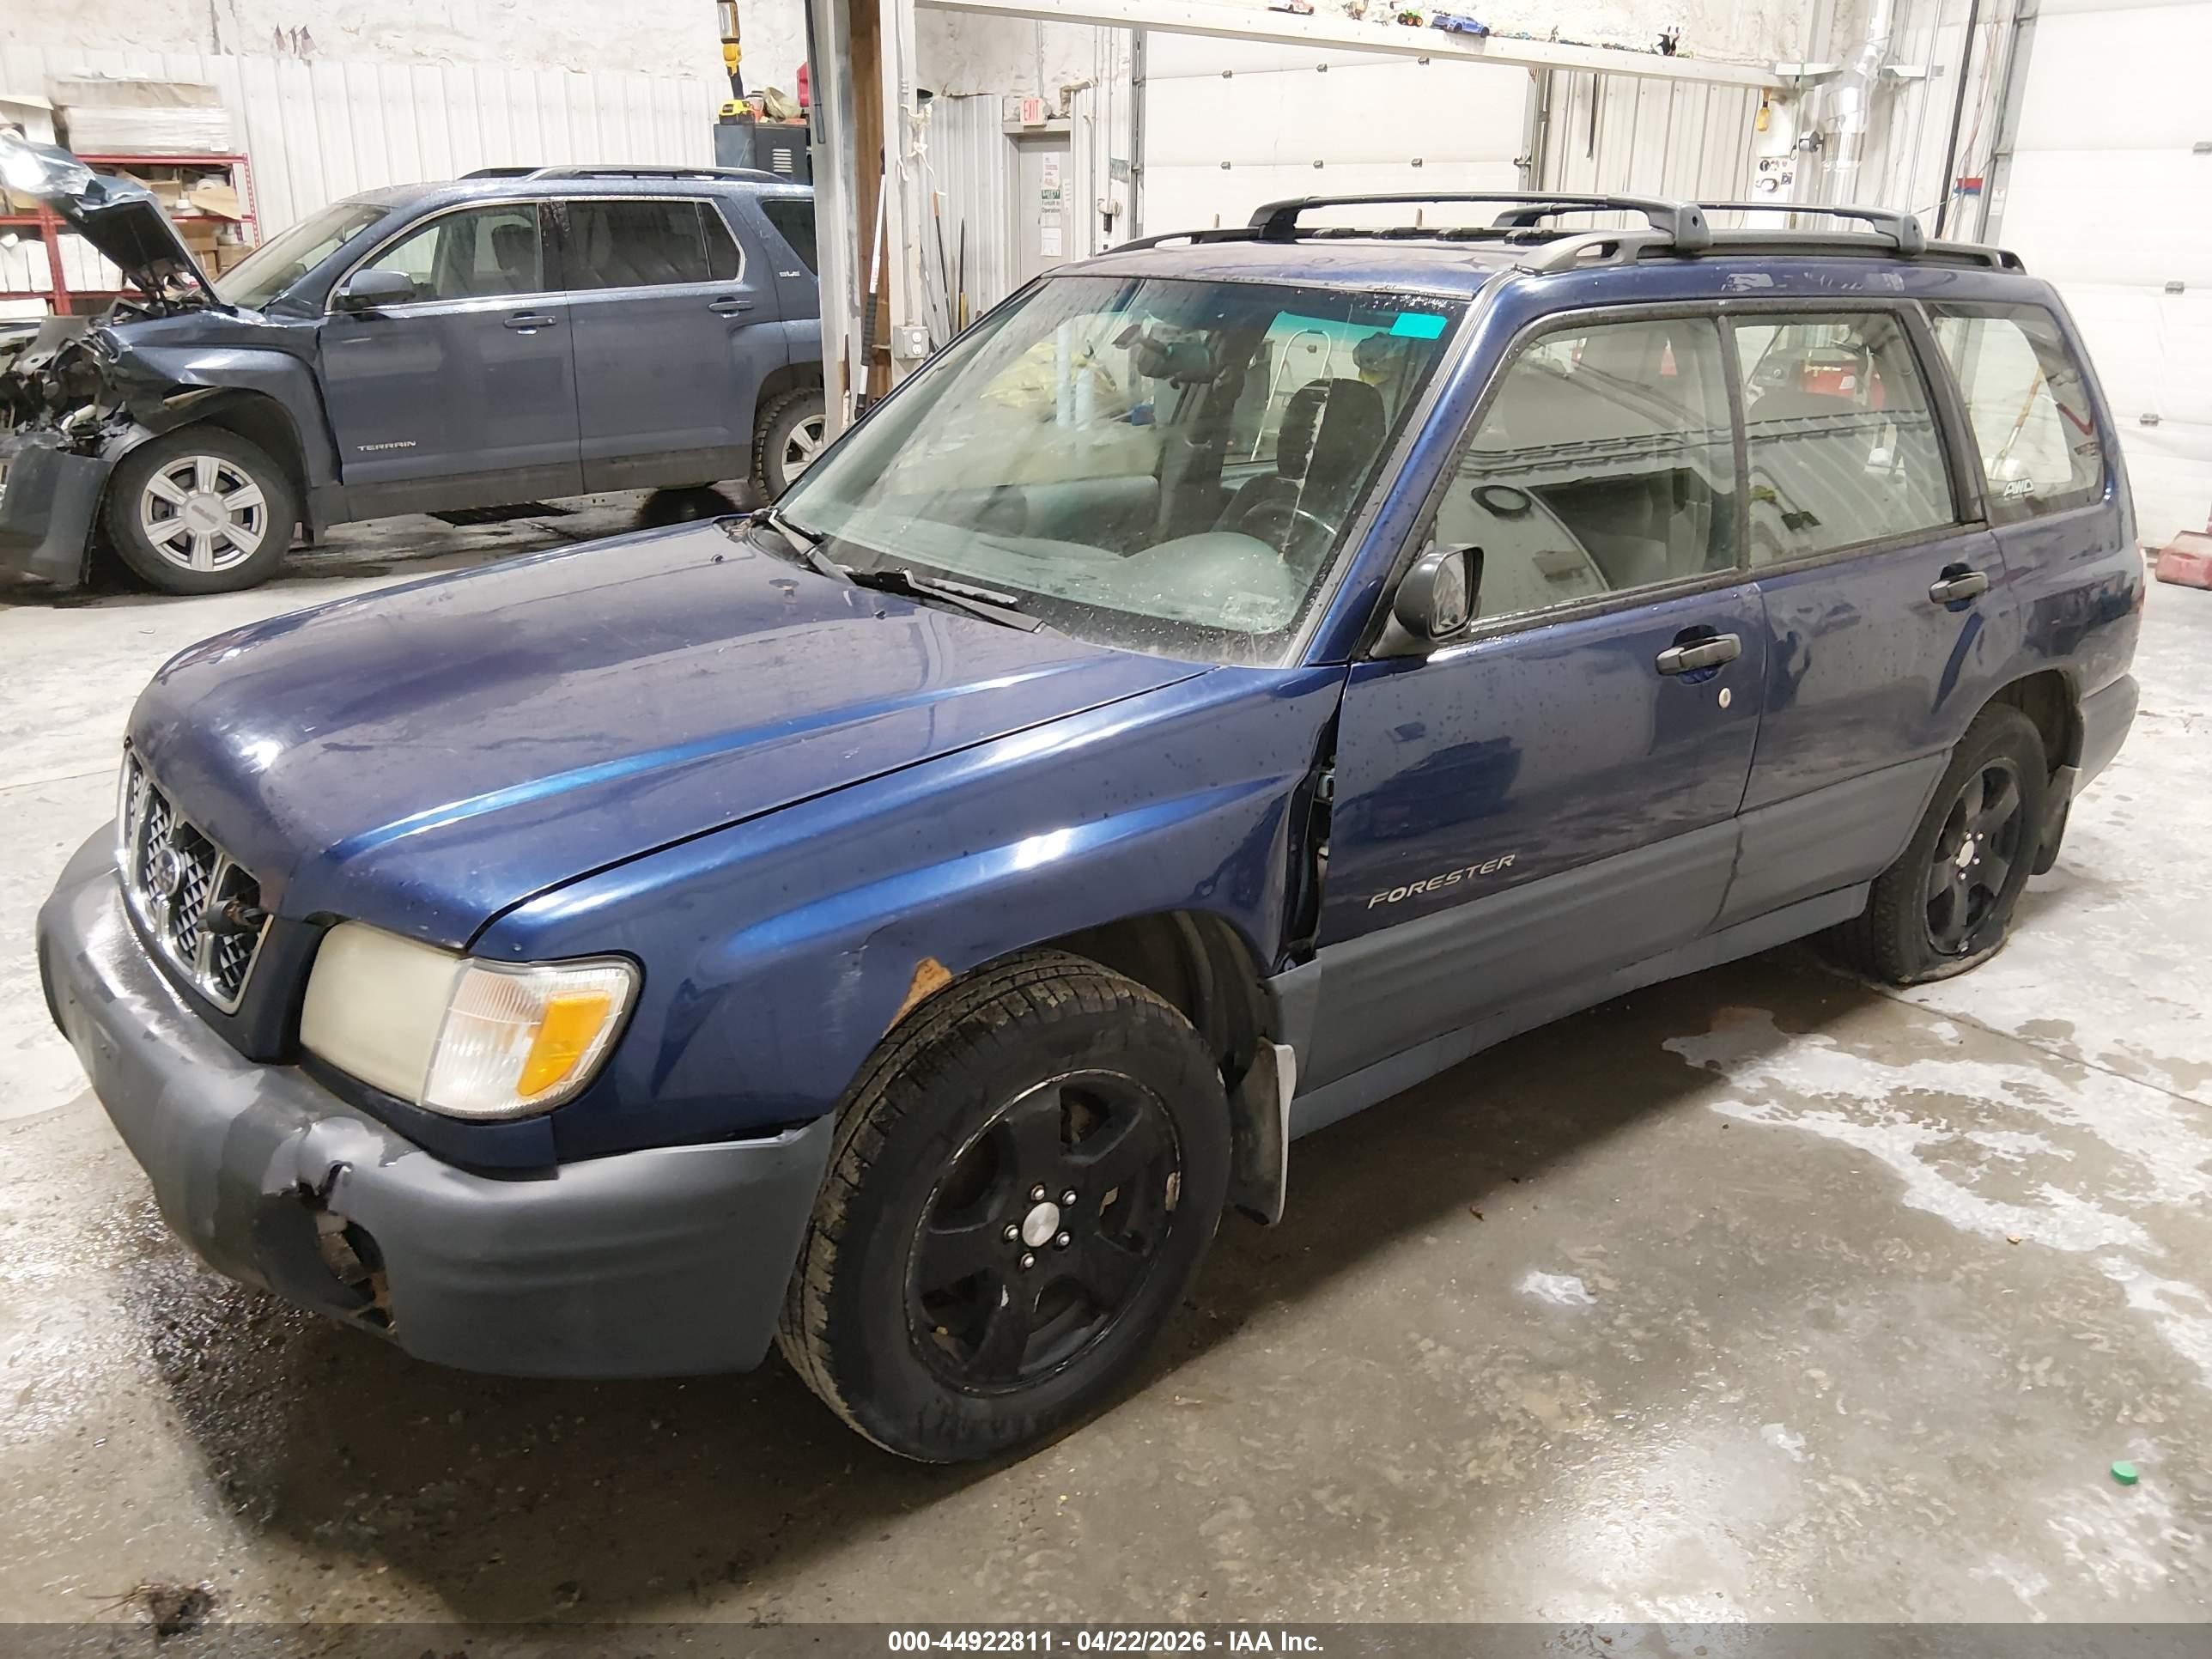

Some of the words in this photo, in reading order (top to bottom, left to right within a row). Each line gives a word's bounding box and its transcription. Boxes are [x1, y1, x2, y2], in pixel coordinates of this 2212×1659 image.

[1023, 99, 1039, 121] EXIT
[357, 441, 416, 451] TERRAIN
[2002, 478, 2034, 496] AWD
[1367, 854, 1516, 910] FORESTER
